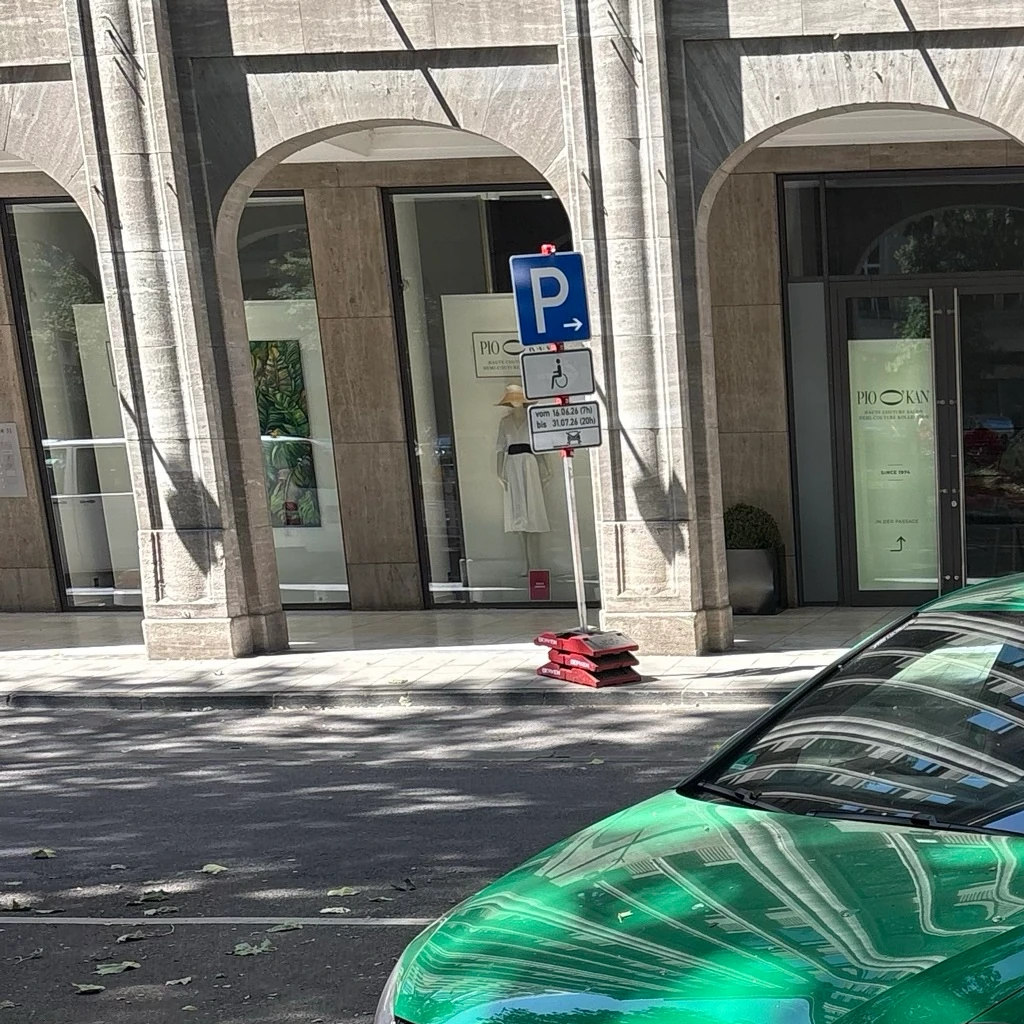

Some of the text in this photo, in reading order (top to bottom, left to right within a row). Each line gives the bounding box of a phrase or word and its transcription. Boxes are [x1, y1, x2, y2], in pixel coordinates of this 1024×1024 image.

[530, 267, 569, 334] P
[480, 340, 500, 355] PIO
[857, 390, 877, 405] PIO
[535, 406, 593, 418] vom 16.06.26 (7h)
[536, 416, 596, 429] bis 31.07.26 (20h)
